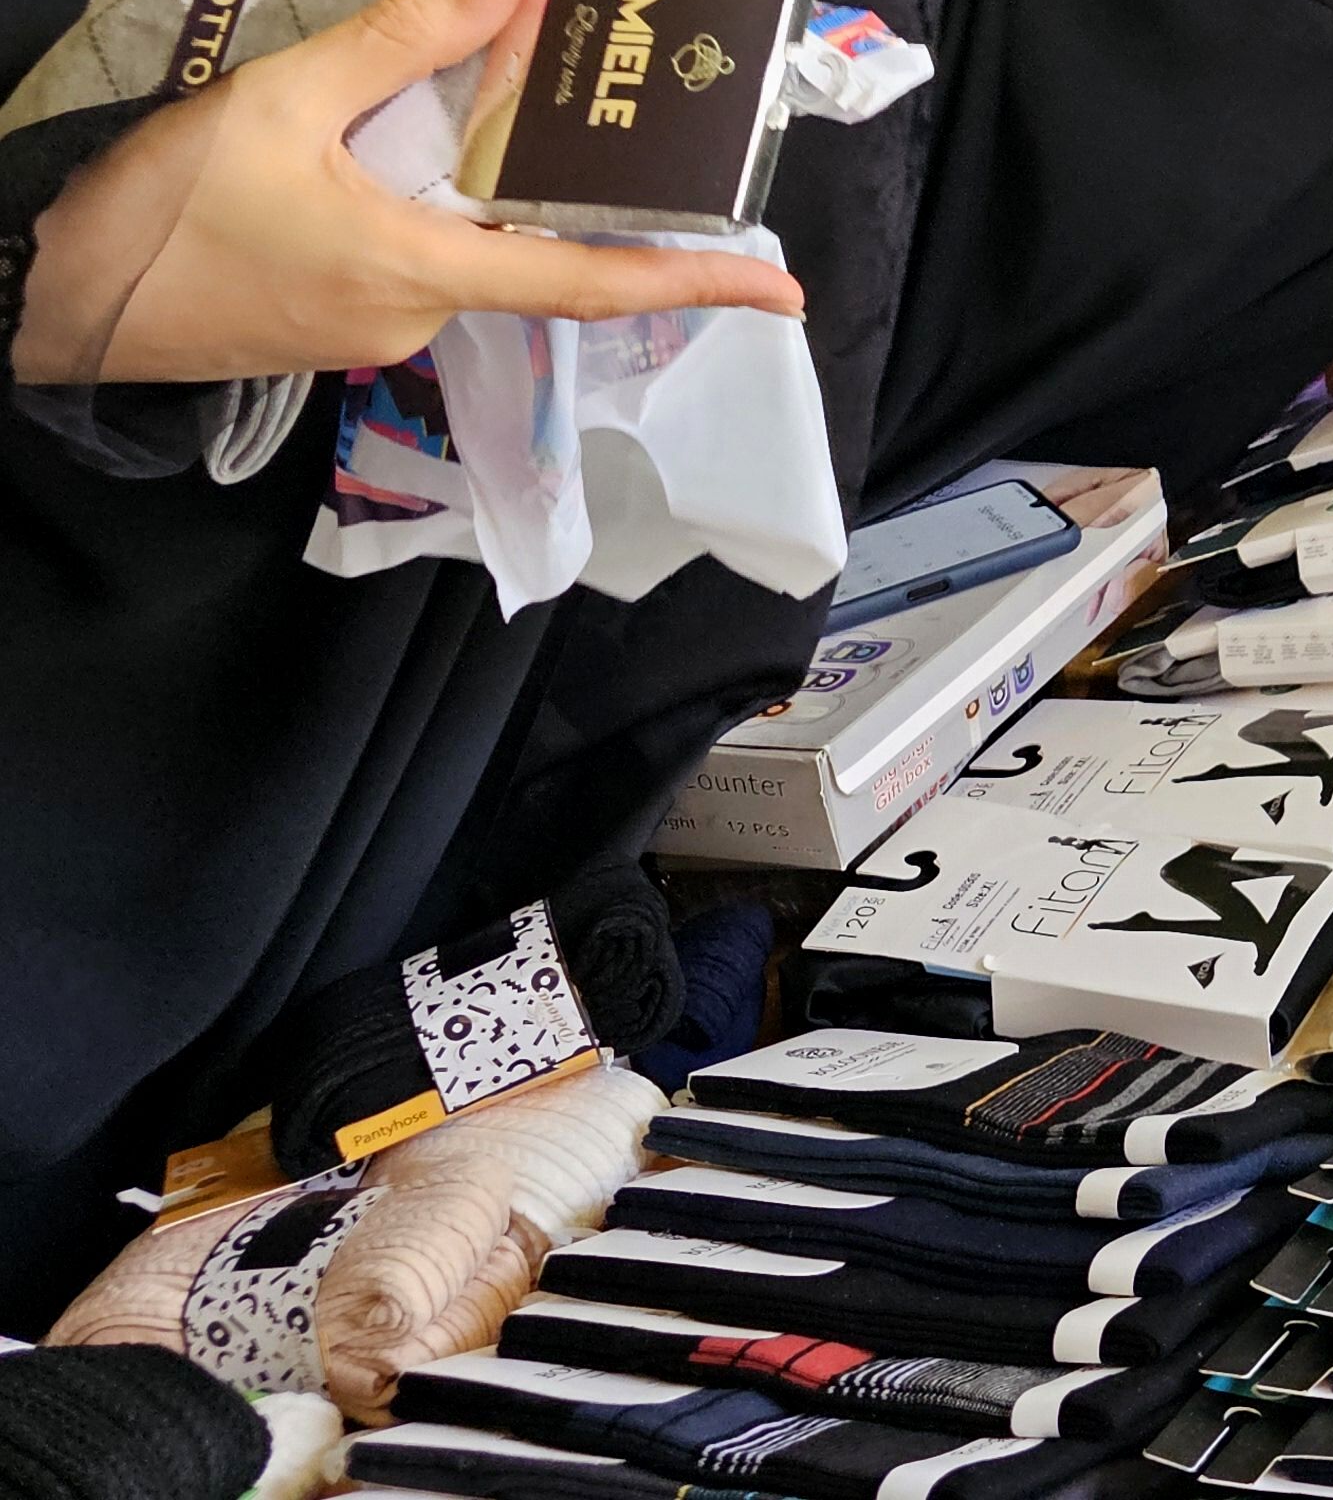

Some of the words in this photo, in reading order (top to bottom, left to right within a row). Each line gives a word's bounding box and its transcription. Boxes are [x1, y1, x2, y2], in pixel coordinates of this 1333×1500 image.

[686, 773, 787, 797] ounter
[904, 757, 932, 786] box
[664, 816, 696, 831] ight
[727, 820, 746, 836] 12
[753, 822, 790, 838] PCS
[836, 905, 877, 939] 120
[353, 1110, 428, 1146] Pantyhose
